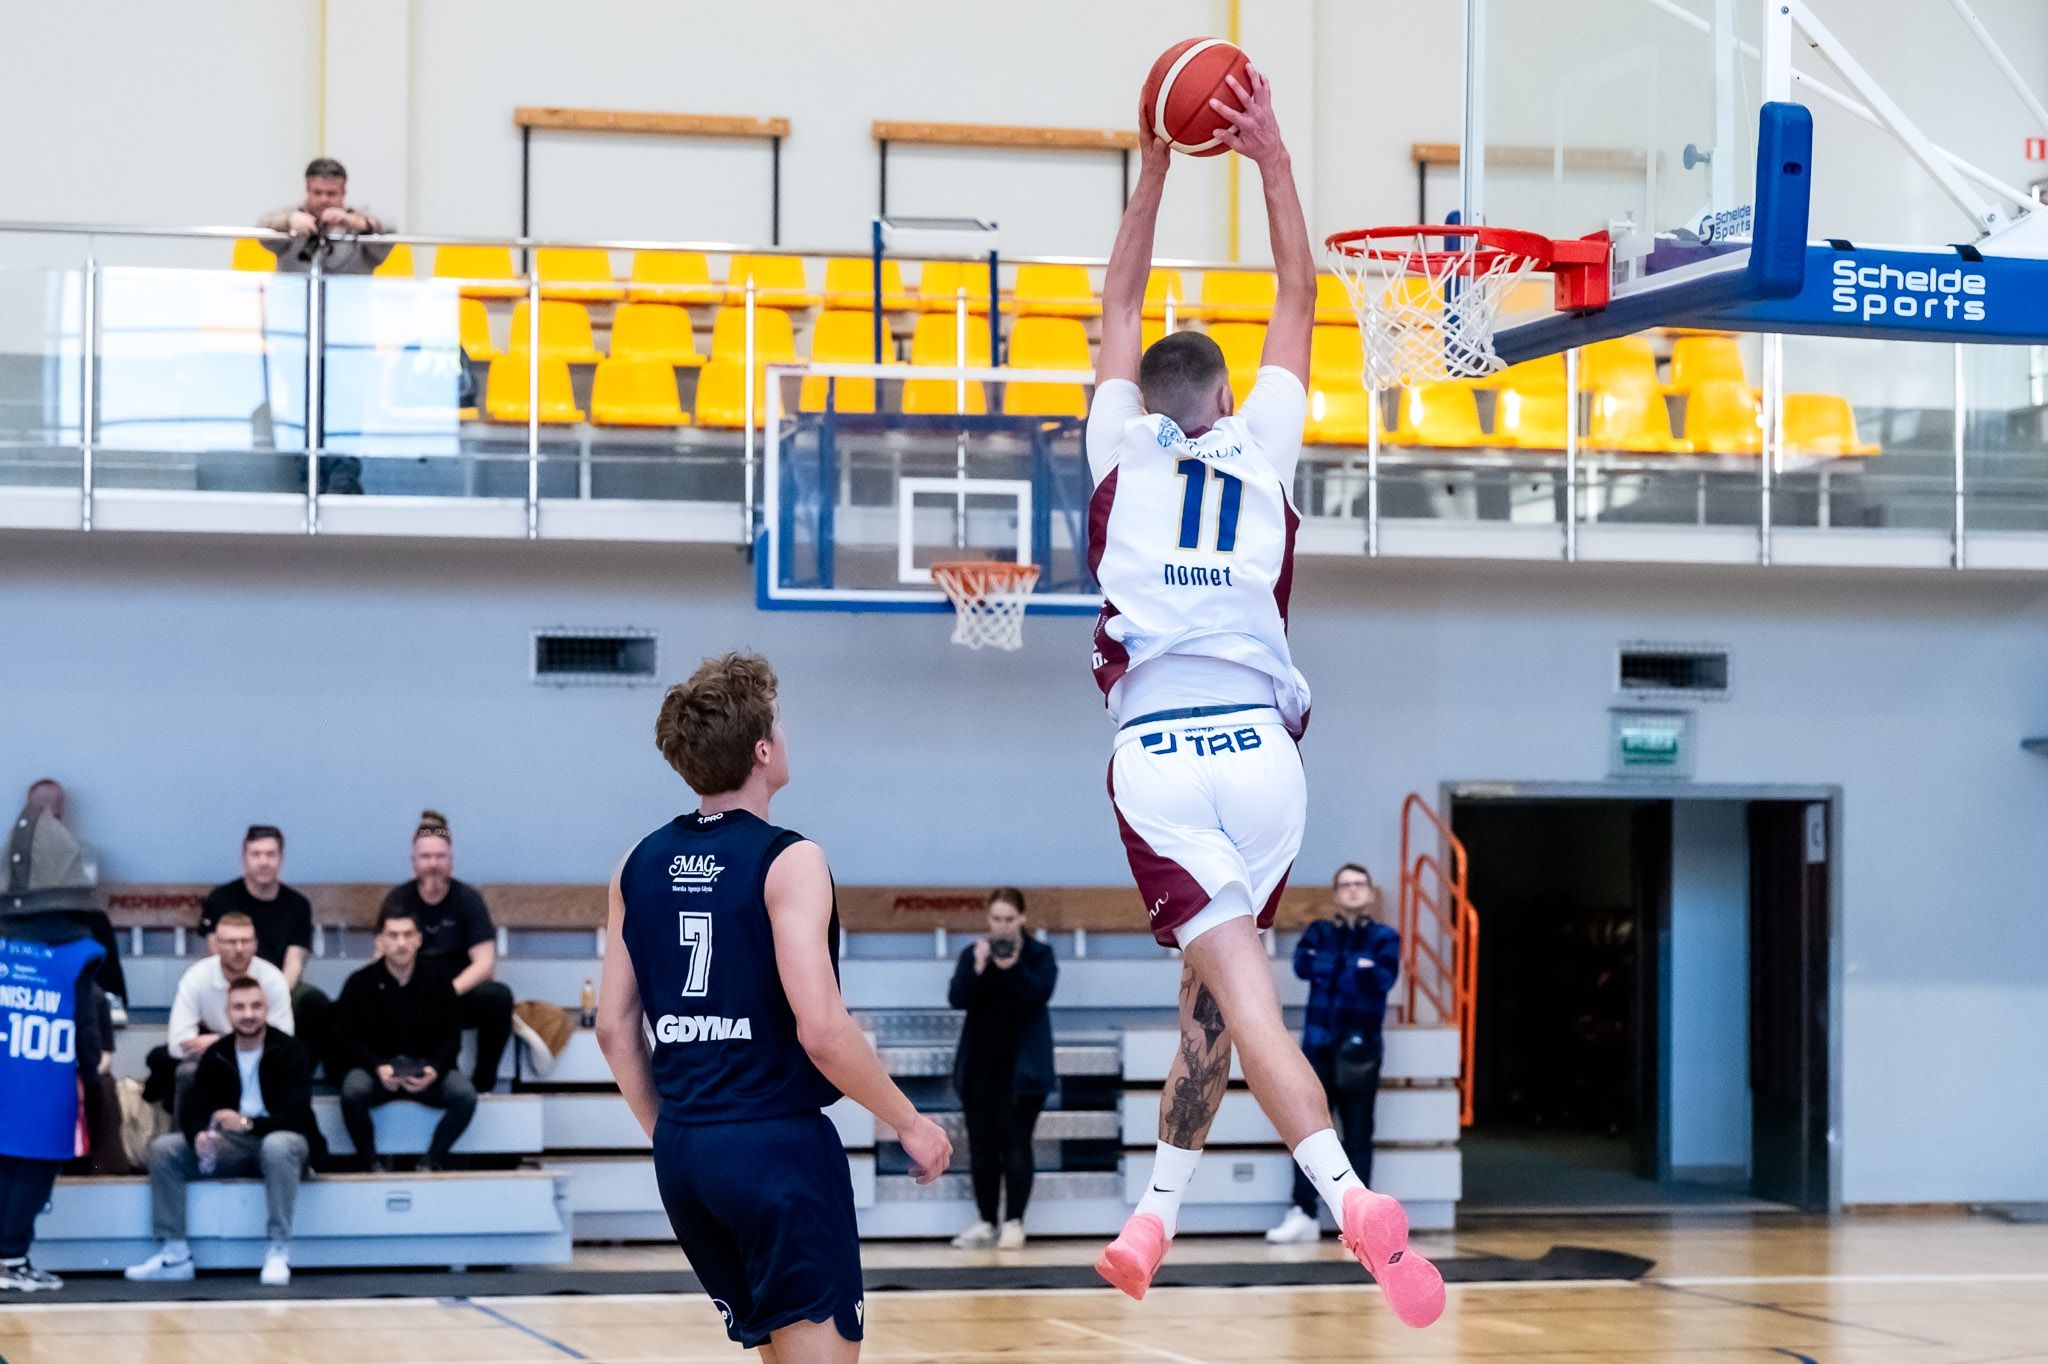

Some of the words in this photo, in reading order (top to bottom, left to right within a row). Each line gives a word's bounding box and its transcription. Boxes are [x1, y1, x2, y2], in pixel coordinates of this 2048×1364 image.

[1715, 205, 1751, 226] Schelde
[1715, 220, 1751, 242] Sports
[1832, 259, 1986, 295] Schelde
[1832, 286, 1986, 321] Sports
[1174, 456, 1245, 555] 11
[1164, 563, 1233, 587] nomet
[1185, 727, 1262, 757] TRB
[668, 854, 716, 877] MAG
[679, 911, 713, 997] 7
[656, 1014, 752, 1044] GDYNIA
